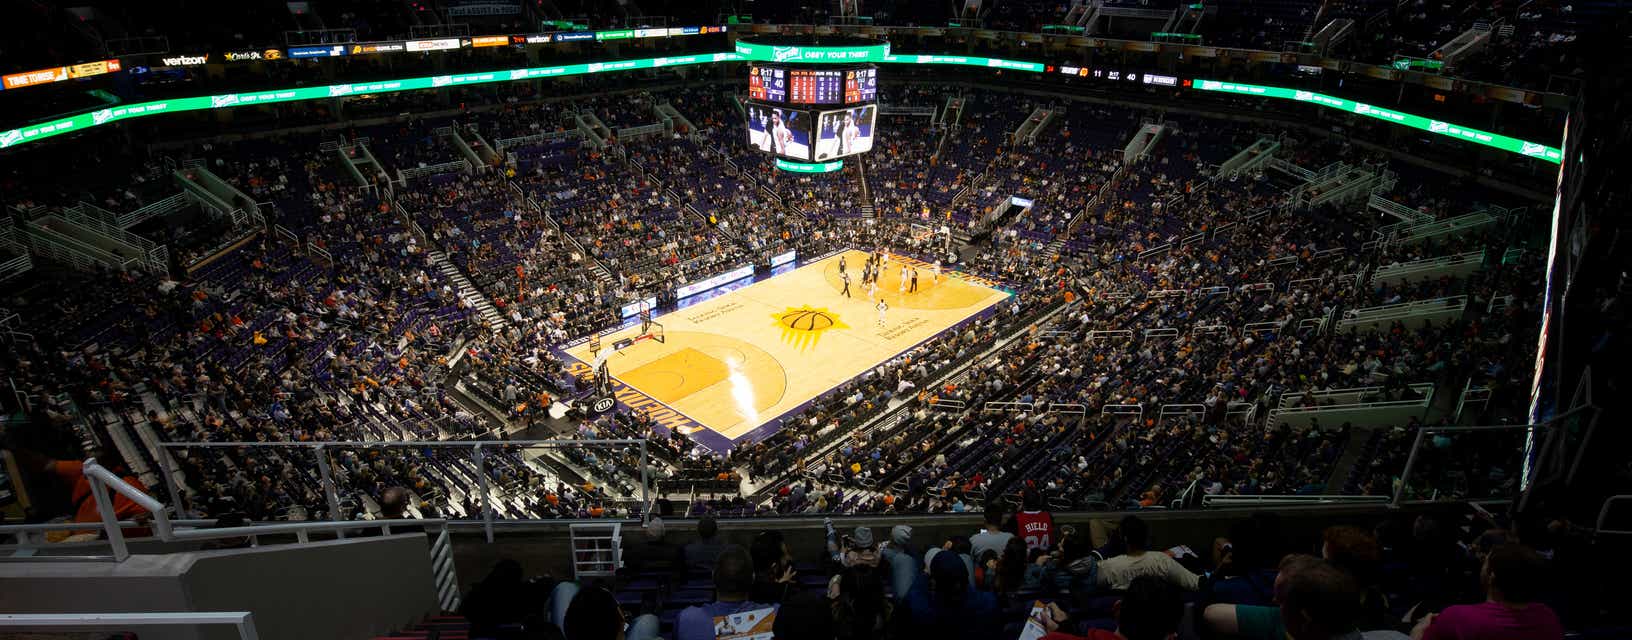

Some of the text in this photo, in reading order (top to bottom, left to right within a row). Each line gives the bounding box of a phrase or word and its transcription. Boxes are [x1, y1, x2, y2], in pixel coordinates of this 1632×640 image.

[805, 50, 869, 59] OBEY YOUR THIRST
[163, 56, 204, 66] verizon
[752, 76, 759, 84] 11
[774, 79, 783, 88] 40
[847, 80, 855, 89] 11
[868, 78, 875, 86] 40
[597, 400, 611, 410] KIA
[1025, 522, 1048, 532] HIELD
